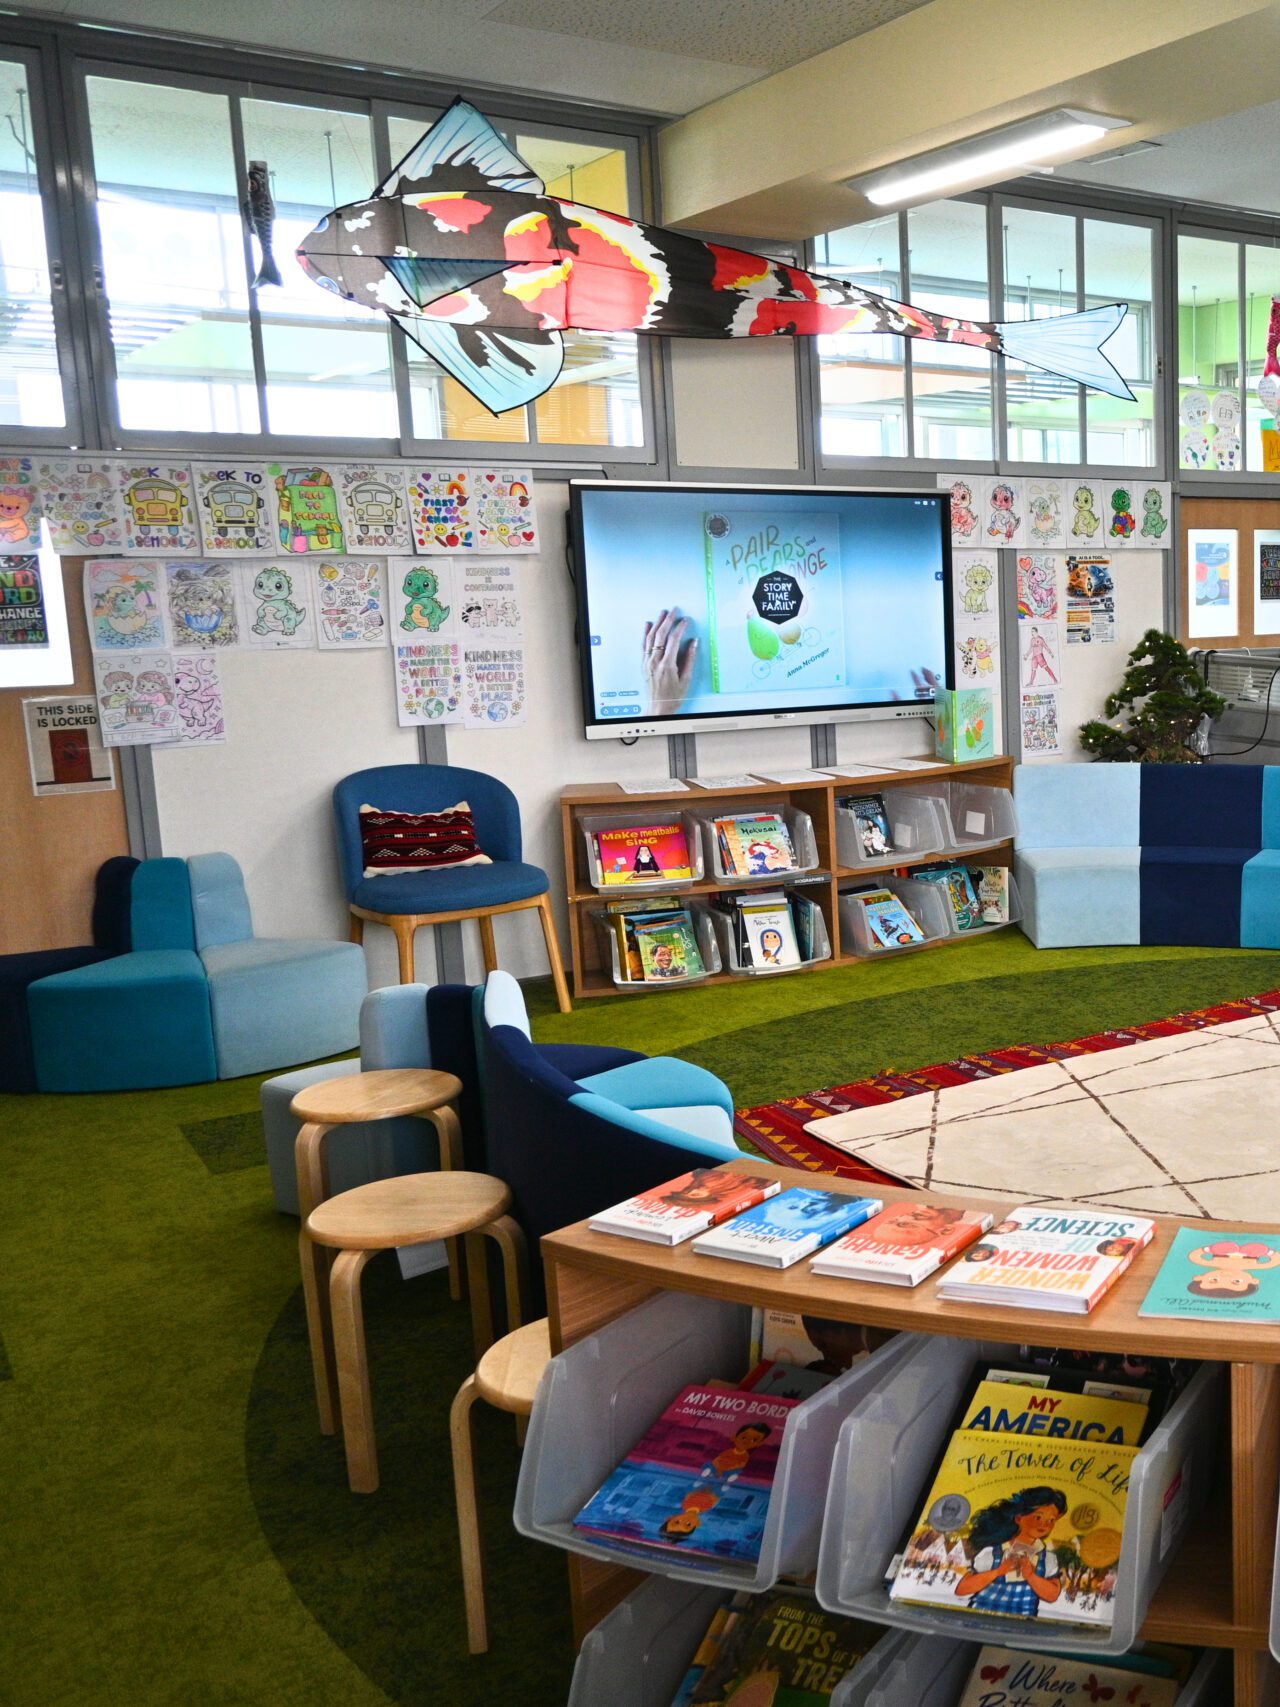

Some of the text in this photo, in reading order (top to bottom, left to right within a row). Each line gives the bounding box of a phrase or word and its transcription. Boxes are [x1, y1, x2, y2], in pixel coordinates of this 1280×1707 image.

[168, 468, 187, 481] TO
[244, 472, 262, 484] TO
[806, 536, 816, 546] and
[730, 525, 780, 571] PAIR
[763, 583, 792, 592] STORY
[767, 592, 789, 600] TIME
[762, 600, 795, 611] FAMILY
[398, 644, 458, 658] KINDNESS
[464, 650, 524, 662] KINDNESS
[786, 648, 830, 678] Anna McGregor
[408, 666, 452, 679] WORLD
[475, 672, 516, 683] WORLD
[416, 687, 449, 698] PLACE
[481, 692, 513, 701] PLACE
[37, 704, 93, 715] THIS SIDE
[38, 716, 97, 728] IS LOCKED
[866, 806, 882, 815] DREAM
[640, 826, 680, 837] meatballs
[794, 876, 824, 884] BIOGRAPHIES
[673, 1204, 698, 1219] da
[1020, 1216, 1135, 1238] SCIENCE
[1063, 1236, 1099, 1254] OF
[990, 1249, 1101, 1272] WOMEN
[966, 1266, 1092, 1290] WONDER
[1161, 1297, 1272, 1310] Muhammad Ali
[769, 1316, 782, 1324] FLOYD
[684, 1391, 709, 1406] MY
[711, 1395, 745, 1412] TWO
[1027, 1396, 1062, 1414] MY
[682, 1406, 736, 1422] DAVID BOWLES
[968, 1406, 1126, 1445] AMERICA
[958, 1453, 1000, 1476] The
[1002, 1449, 1064, 1469] Tower
[1070, 1457, 1095, 1482] of
[777, 1606, 825, 1625] FROM THE
[766, 1618, 837, 1659] TOPS
[832, 1649, 849, 1663] OF
[1009, 1660, 1076, 1694] Where
